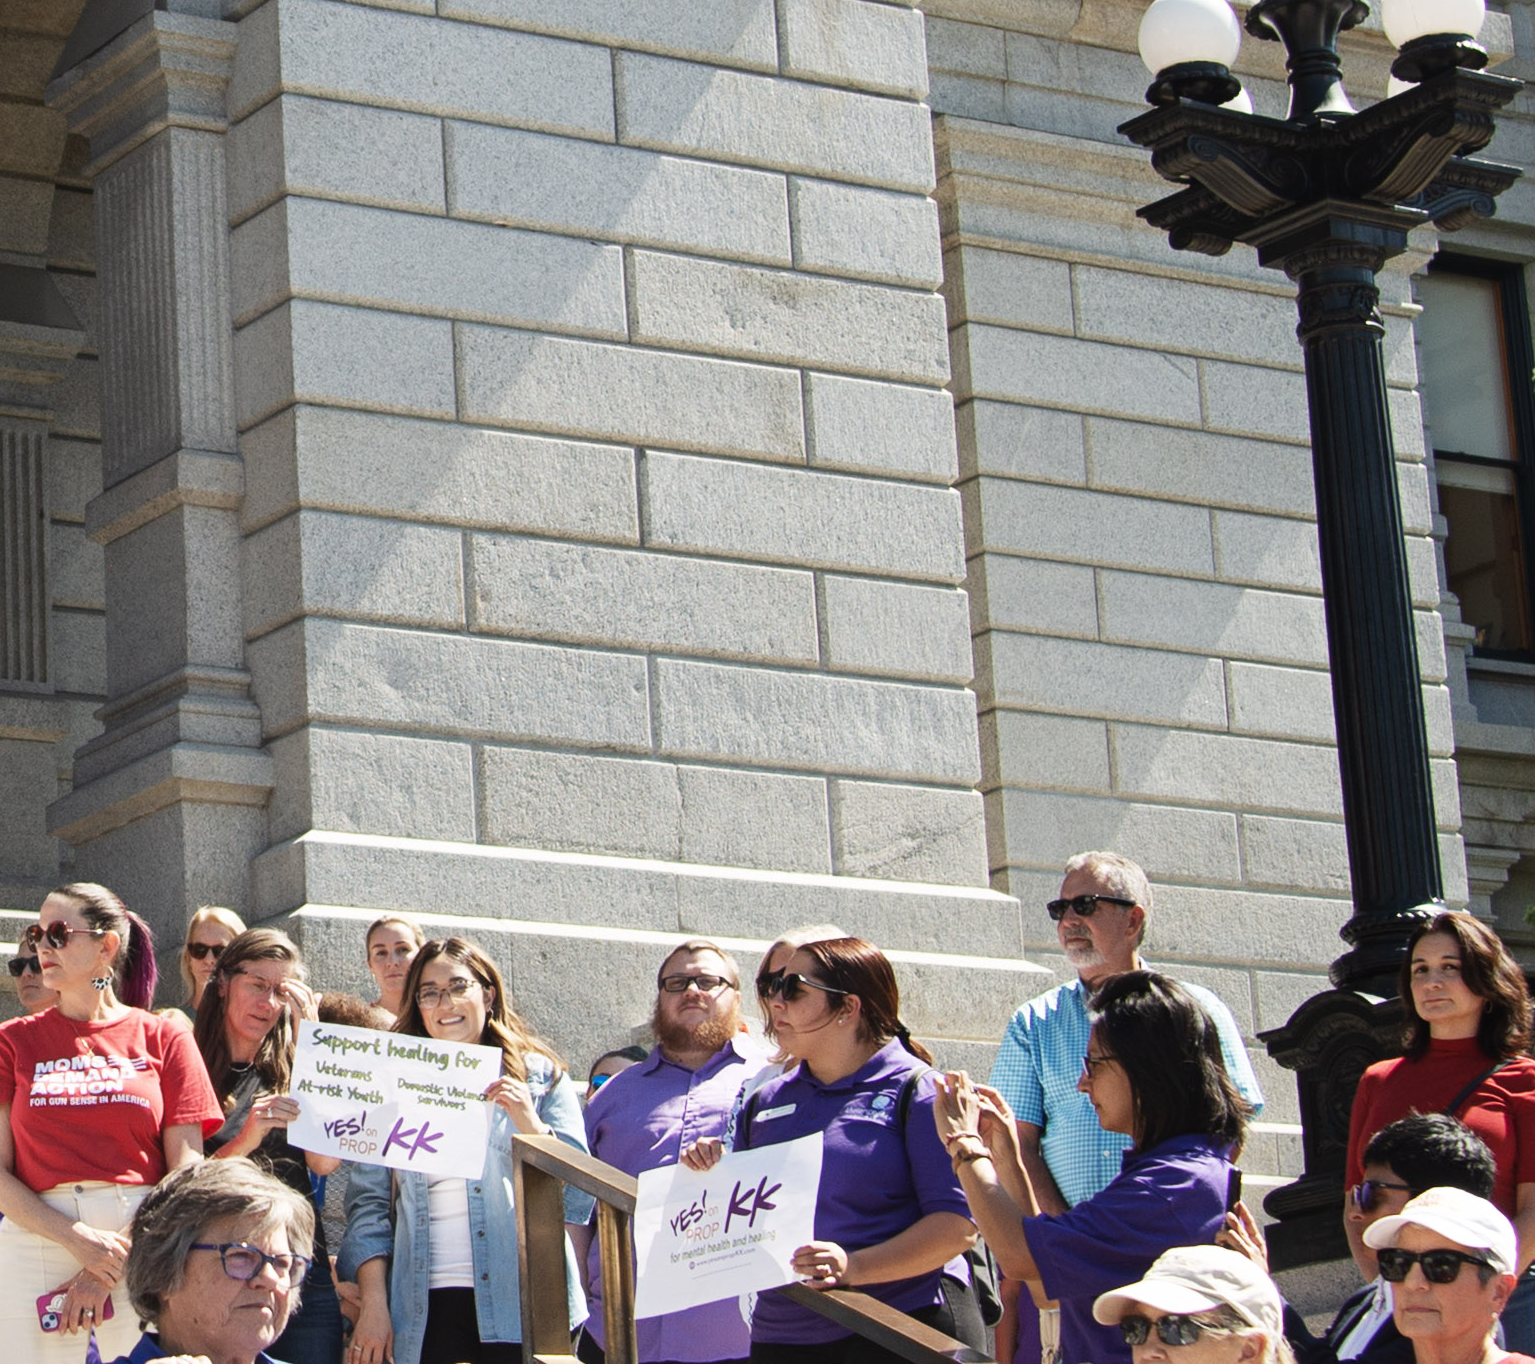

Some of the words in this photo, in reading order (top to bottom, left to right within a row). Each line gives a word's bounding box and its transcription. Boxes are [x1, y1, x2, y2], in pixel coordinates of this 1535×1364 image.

[312, 1028, 381, 1055] Support
[387, 1039, 449, 1070] healing
[455, 1051, 481, 1070] for
[33, 1066, 136, 1083] DEMAND
[35, 1055, 107, 1074] MOMS
[316, 1061, 373, 1082] Veterans
[30, 1079, 123, 1095] ACTION
[298, 1079, 343, 1097] At-risk
[347, 1086, 384, 1104] Youth
[397, 1078, 443, 1095] Domestic
[30, 1098, 46, 1107] FOR
[49, 1097, 67, 1106] GUN
[70, 1096, 97, 1105] SENSE
[111, 1094, 150, 1108] AMERICA
[324, 1110, 367, 1138] YES!
[365, 1128, 378, 1137] on
[339, 1138, 377, 1155] PROP
[382, 1117, 444, 1160] KK
[670, 1189, 707, 1236] YES!
[708, 1206, 719, 1217] on
[724, 1175, 782, 1234] KK
[686, 1222, 720, 1244] PROP
[670, 1252, 680, 1263] for
[682, 1244, 705, 1260] mental
[707, 1239, 730, 1252] health
[732, 1235, 746, 1248] and
